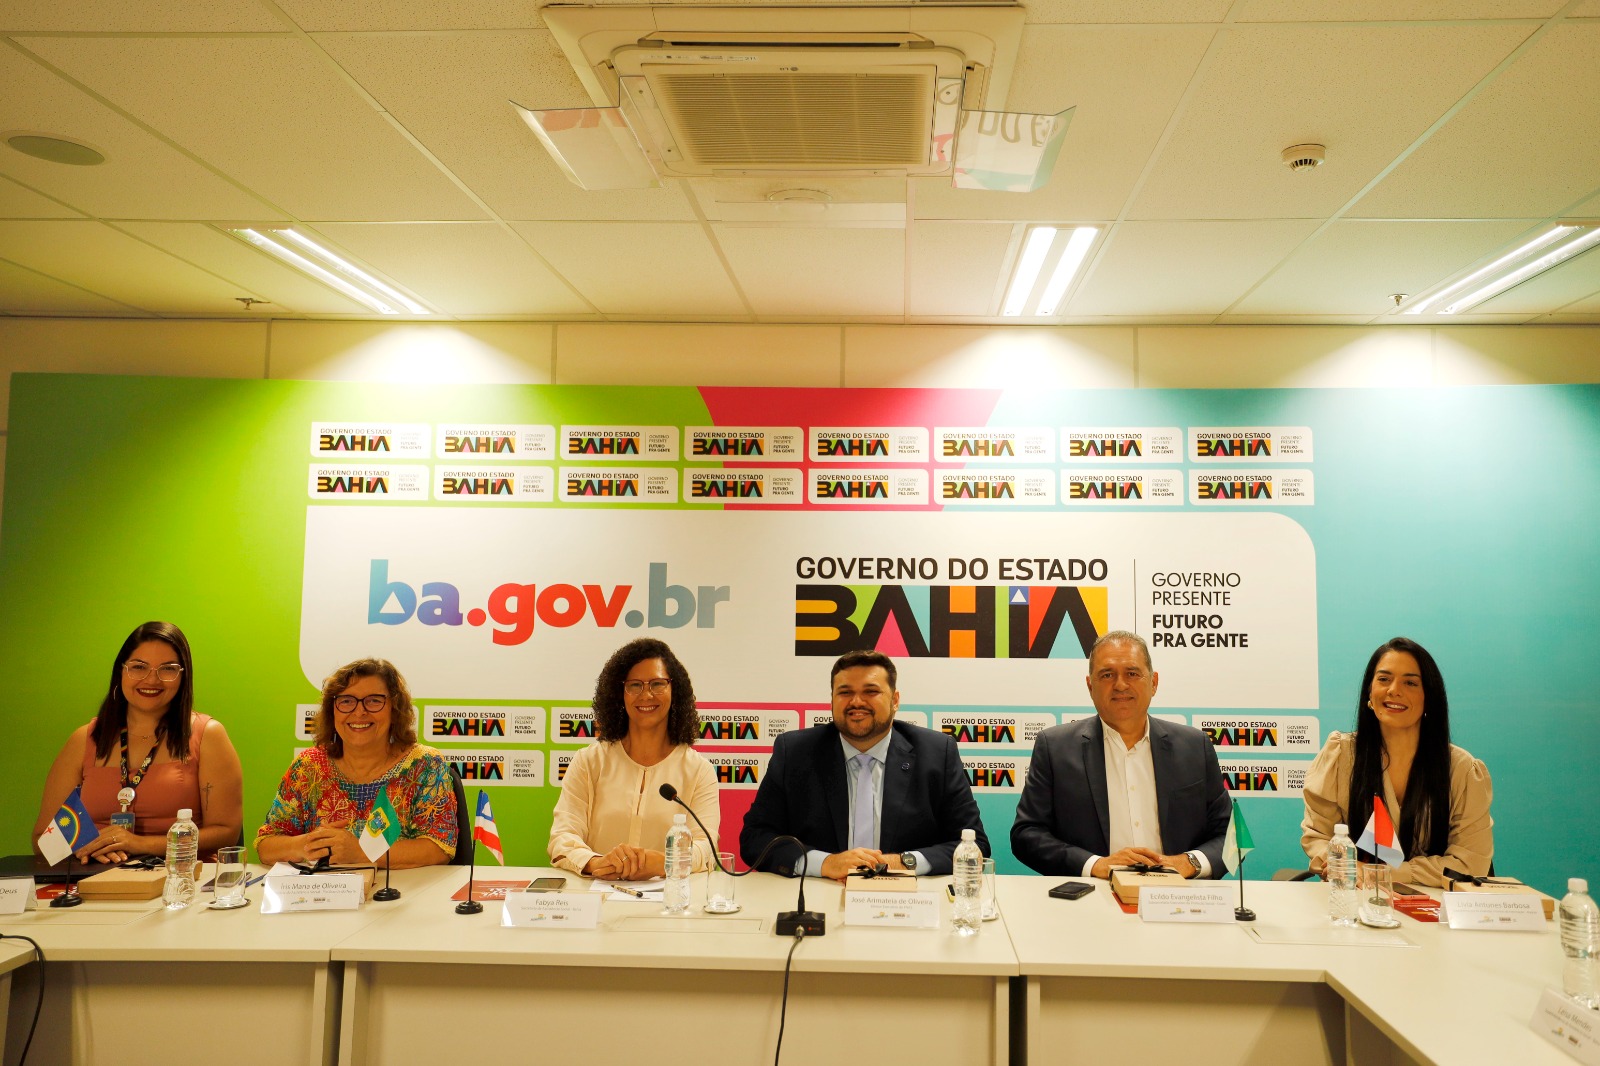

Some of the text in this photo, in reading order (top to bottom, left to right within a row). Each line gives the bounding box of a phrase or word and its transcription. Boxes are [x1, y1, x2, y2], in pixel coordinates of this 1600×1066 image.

[320, 435, 390, 451] BAHIA
[445, 437, 515, 453] BAHIA
[569, 438, 639, 454] BAHIA
[693, 439, 763, 455] BAHIA
[818, 440, 888, 455] BAHIA
[943, 440, 1014, 456] BAHIA
[1070, 440, 1142, 456] BAHIA
[1197, 440, 1271, 456] BAHIA
[317, 477, 388, 493] BAHIA
[443, 478, 513, 494] BAHIA
[567, 480, 638, 496] BAHIA
[692, 481, 763, 497] BAHIA
[817, 482, 888, 498] BAHIA
[943, 482, 1014, 498] BAHIA
[1070, 482, 1142, 499] BAHIA
[1198, 482, 1272, 499] BAHIA
[796, 557, 1107, 581] GOVERNO DO ESTADO
[1152, 573, 1241, 588] GOVERNO
[368, 559, 730, 646] ba.gov.br
[1153, 591, 1231, 606] PRESENTE
[795, 584, 1107, 658] BAHIA
[1153, 614, 1223, 629] FUTURO
[1153, 632, 1248, 648] PRA GENTE
[433, 719, 505, 736] BAHIA
[700, 722, 759, 739] AHIA
[1202, 728, 1277, 746] BAHIA
[449, 762, 504, 780] AHIA
[717, 766, 758, 783] HIA
